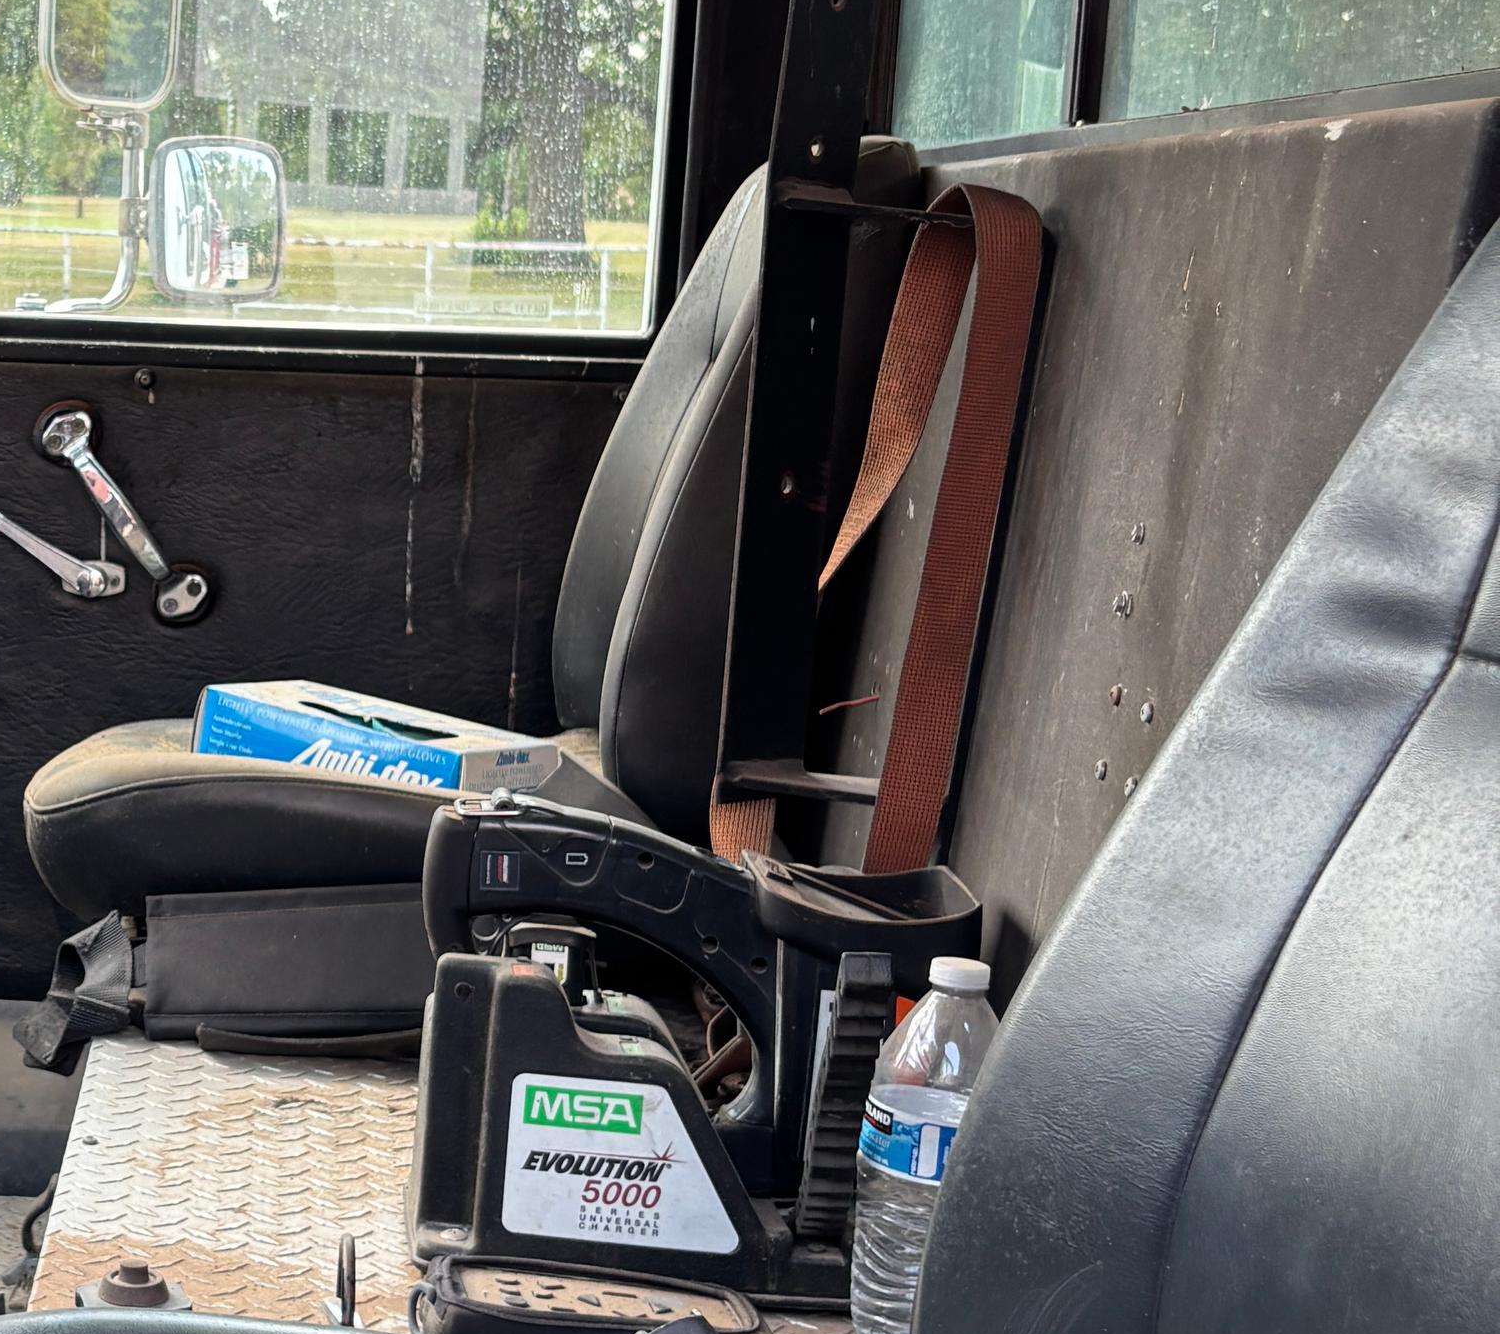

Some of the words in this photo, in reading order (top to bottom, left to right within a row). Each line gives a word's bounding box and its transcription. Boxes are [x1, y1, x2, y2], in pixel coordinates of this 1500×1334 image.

[407, 747, 448, 766] GLOVES
[531, 1091, 636, 1128] MSA
[521, 1150, 668, 1182] EVOLUTION
[581, 1179, 662, 1209] 5000
[579, 1205, 660, 1220] SERIES
[579, 1213, 660, 1229] UNIVERSAL
[578, 1222, 659, 1237] CHARGER
